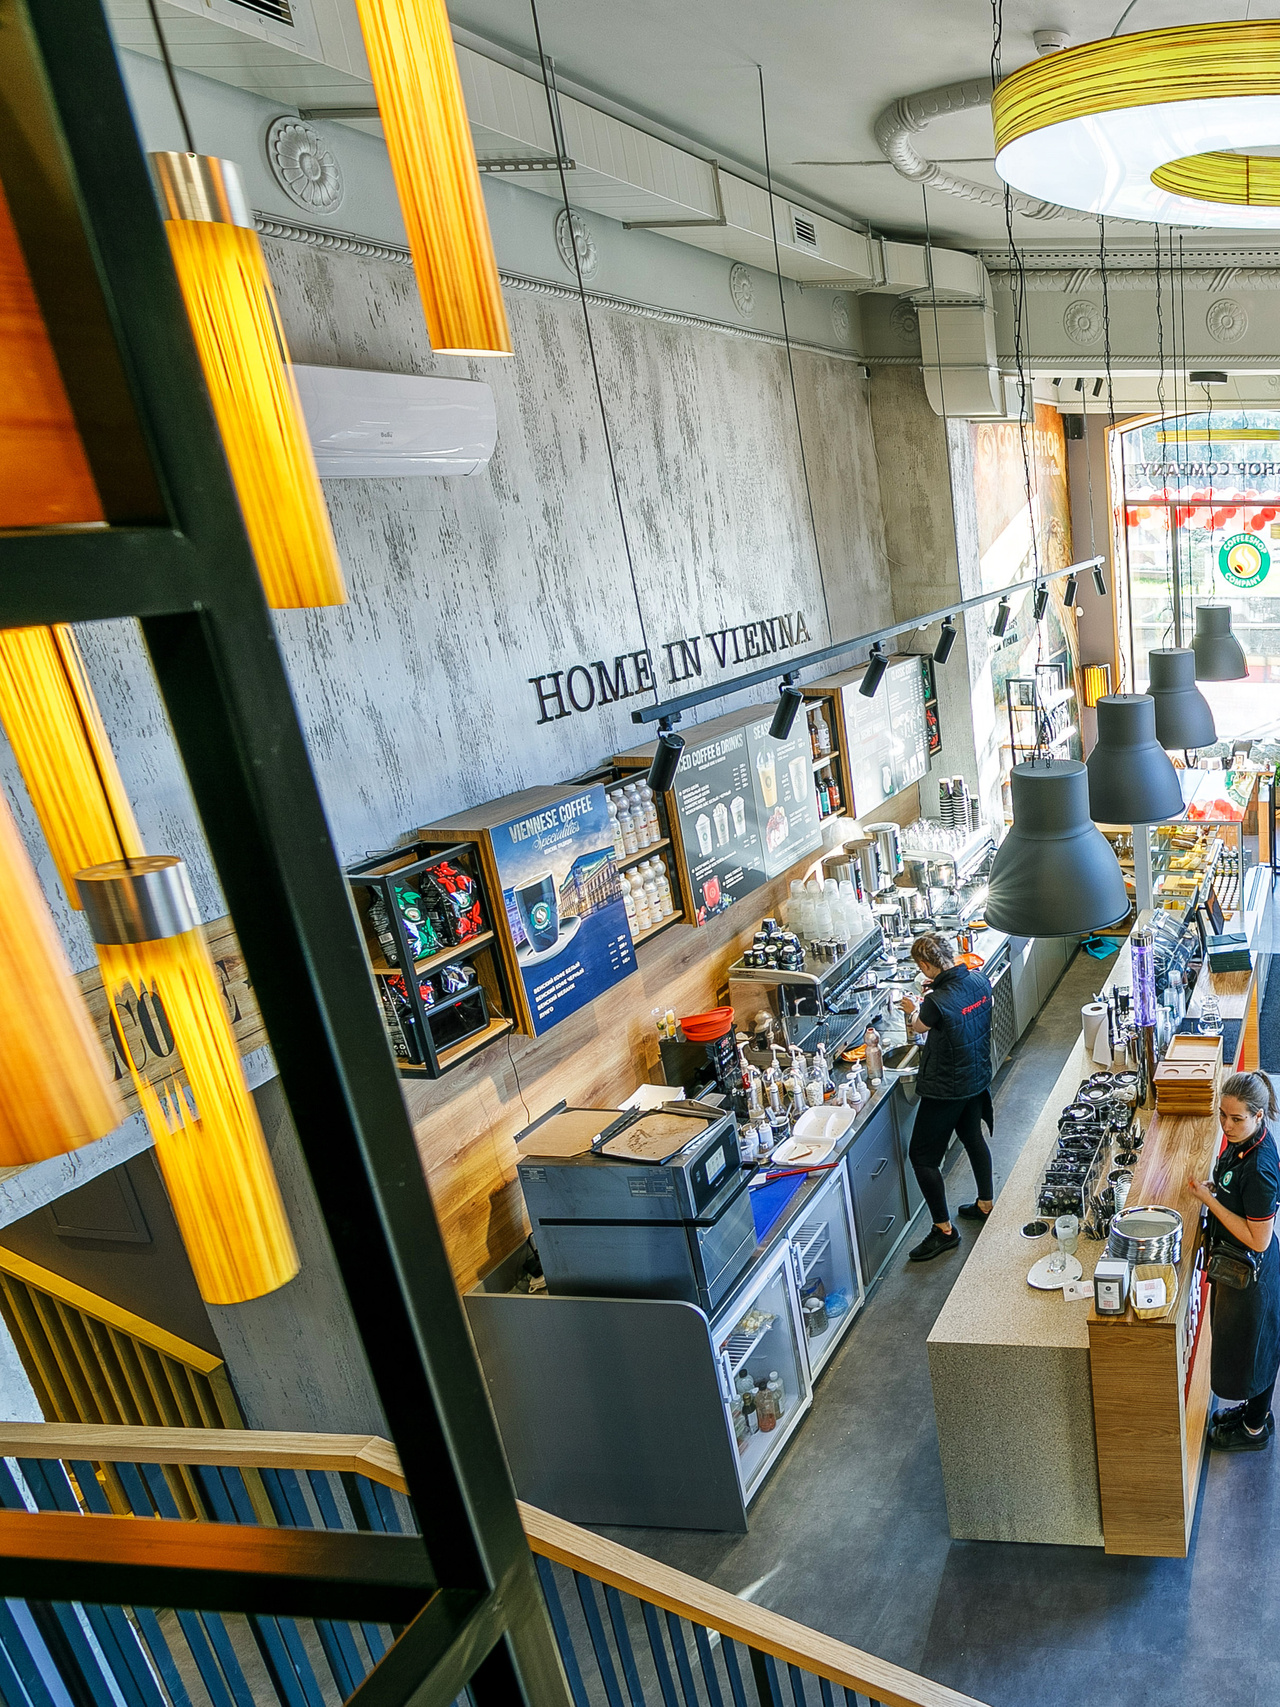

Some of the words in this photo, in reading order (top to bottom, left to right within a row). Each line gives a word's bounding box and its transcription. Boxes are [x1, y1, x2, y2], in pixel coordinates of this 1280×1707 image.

[1223, 534, 1268, 554] COFFEESHOP
[1225, 572, 1261, 587] COMPANY
[529, 649, 656, 725] HOME
[662, 636, 702, 684] IN
[706, 610, 811, 668] VIENNA
[691, 744, 717, 767] COFFEE
[720, 733, 744, 754] DRINKS
[508, 809, 559, 844] VIENNESE
[558, 794, 593, 823] COFFEE
